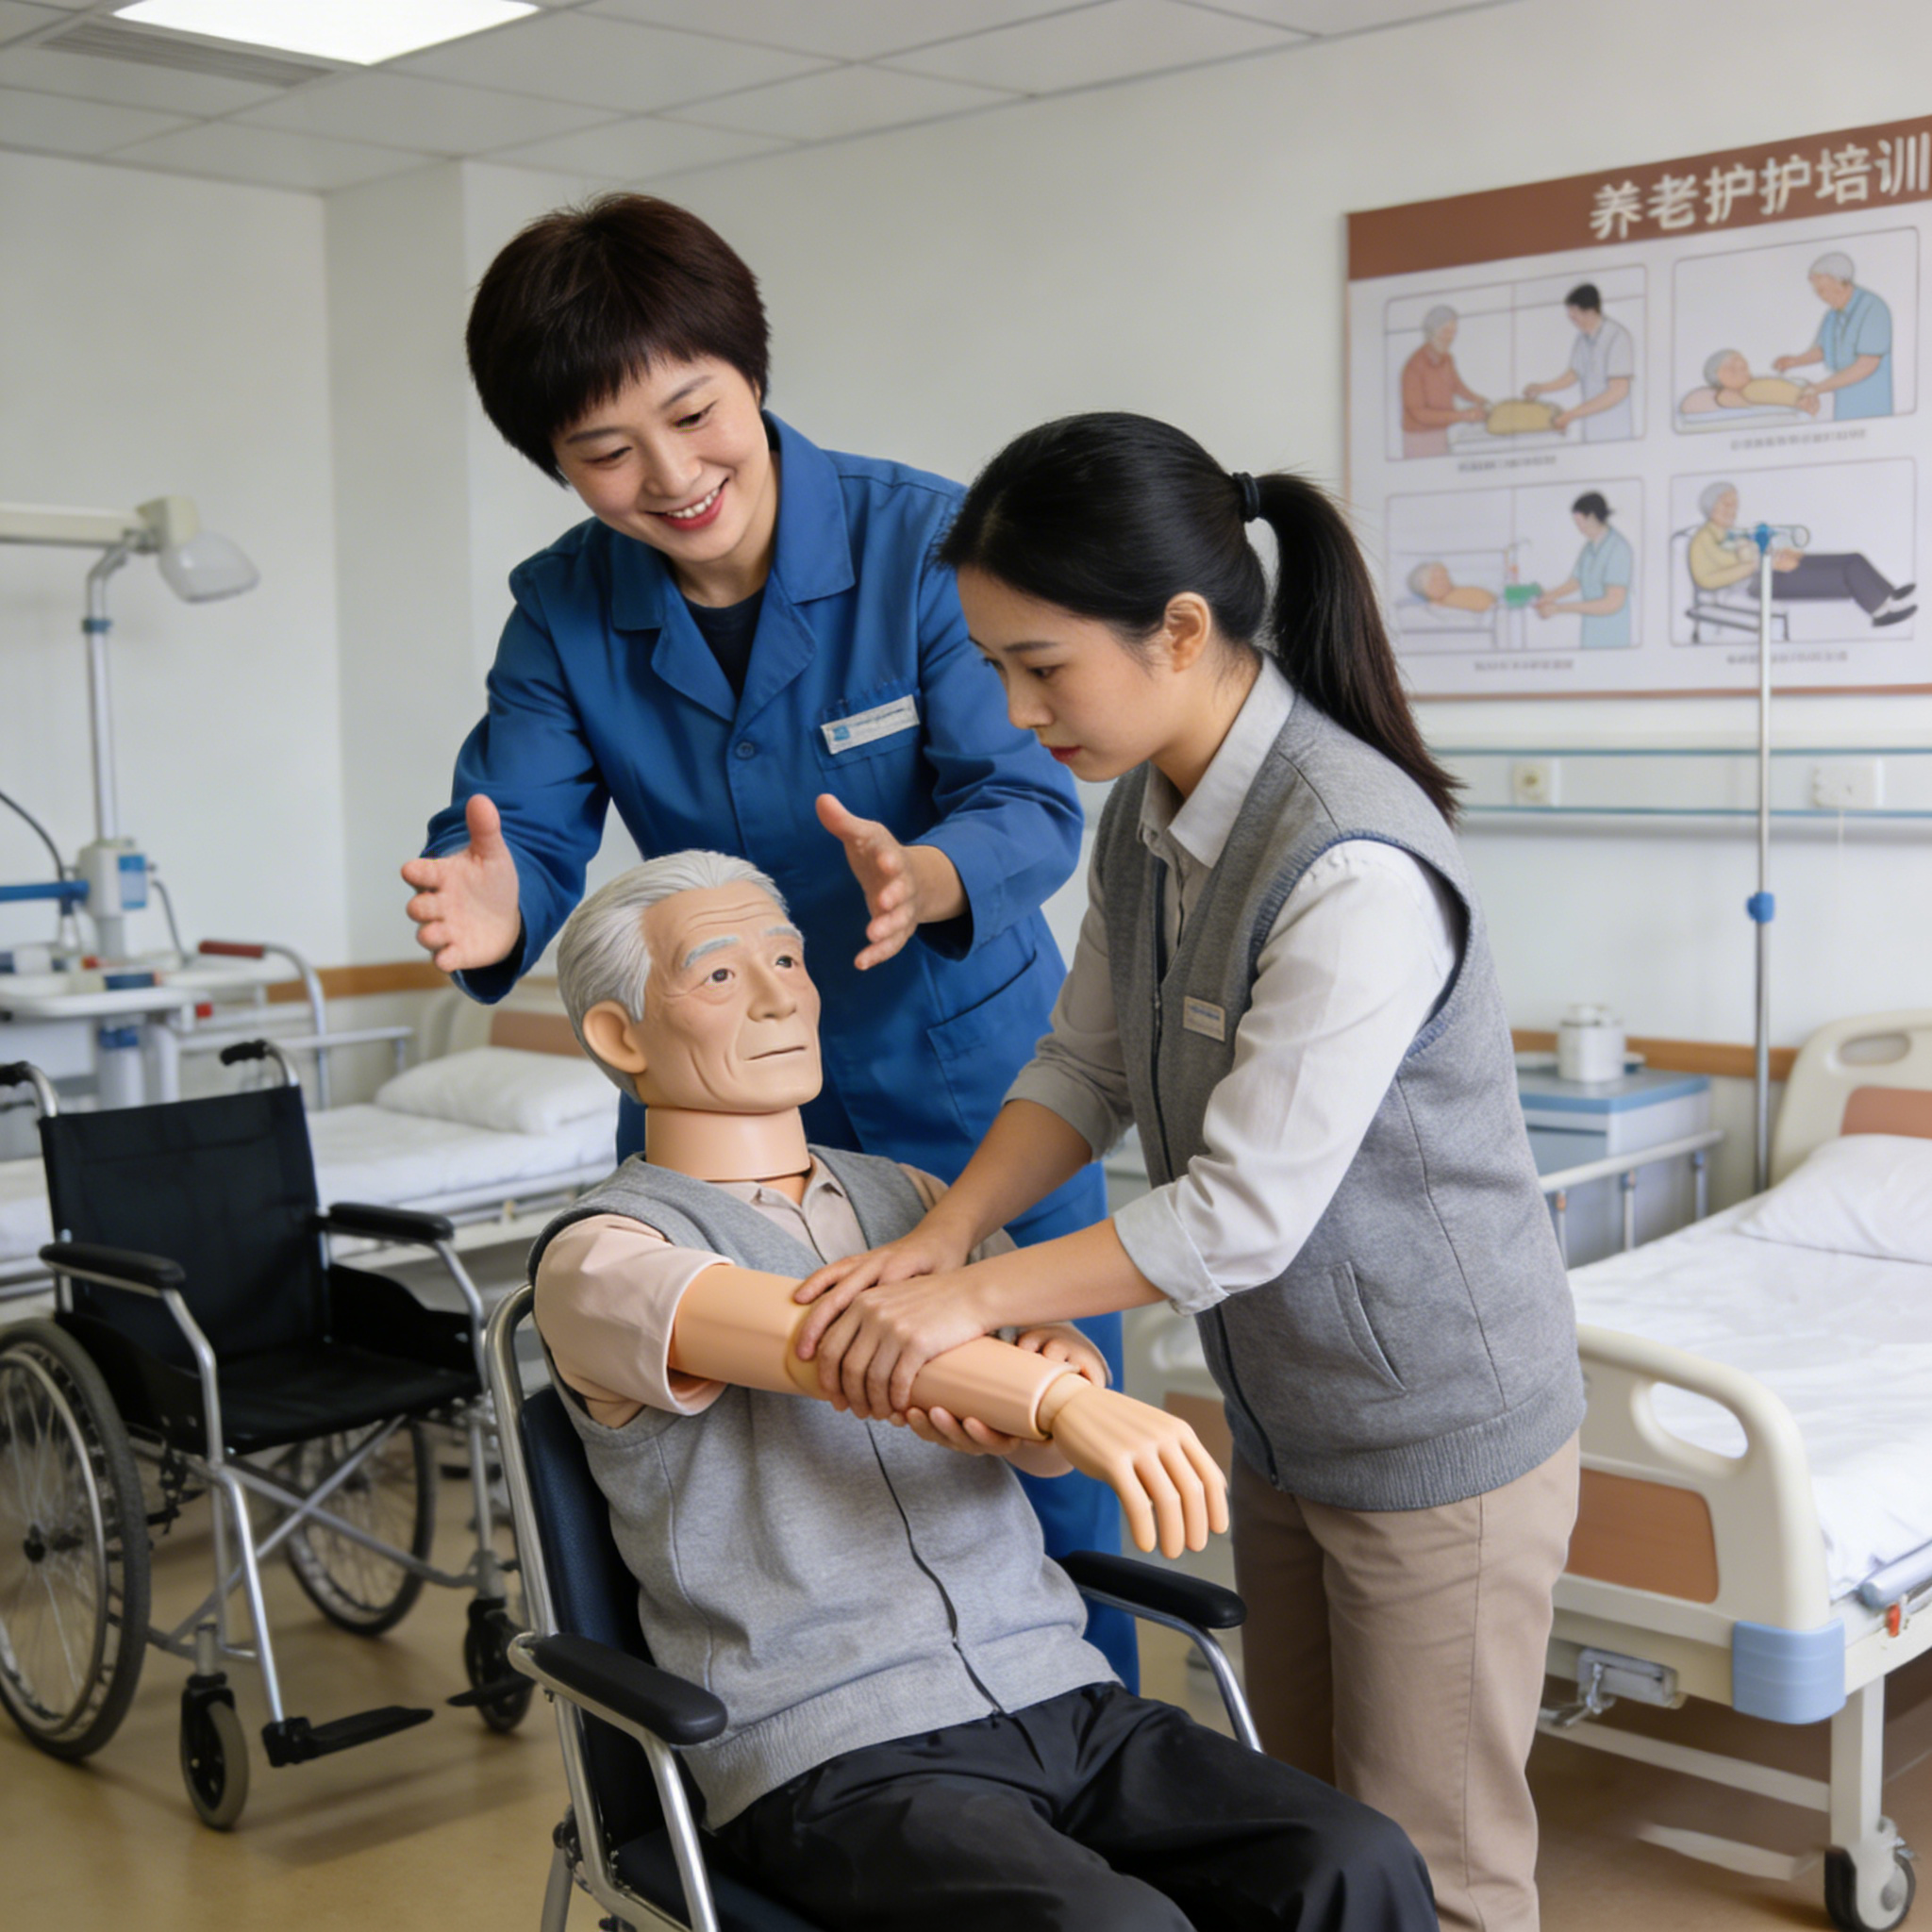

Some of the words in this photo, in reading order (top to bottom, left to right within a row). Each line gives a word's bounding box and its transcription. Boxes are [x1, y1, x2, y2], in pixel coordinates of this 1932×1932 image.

[1590, 131, 1931, 240] 养老护护培训
